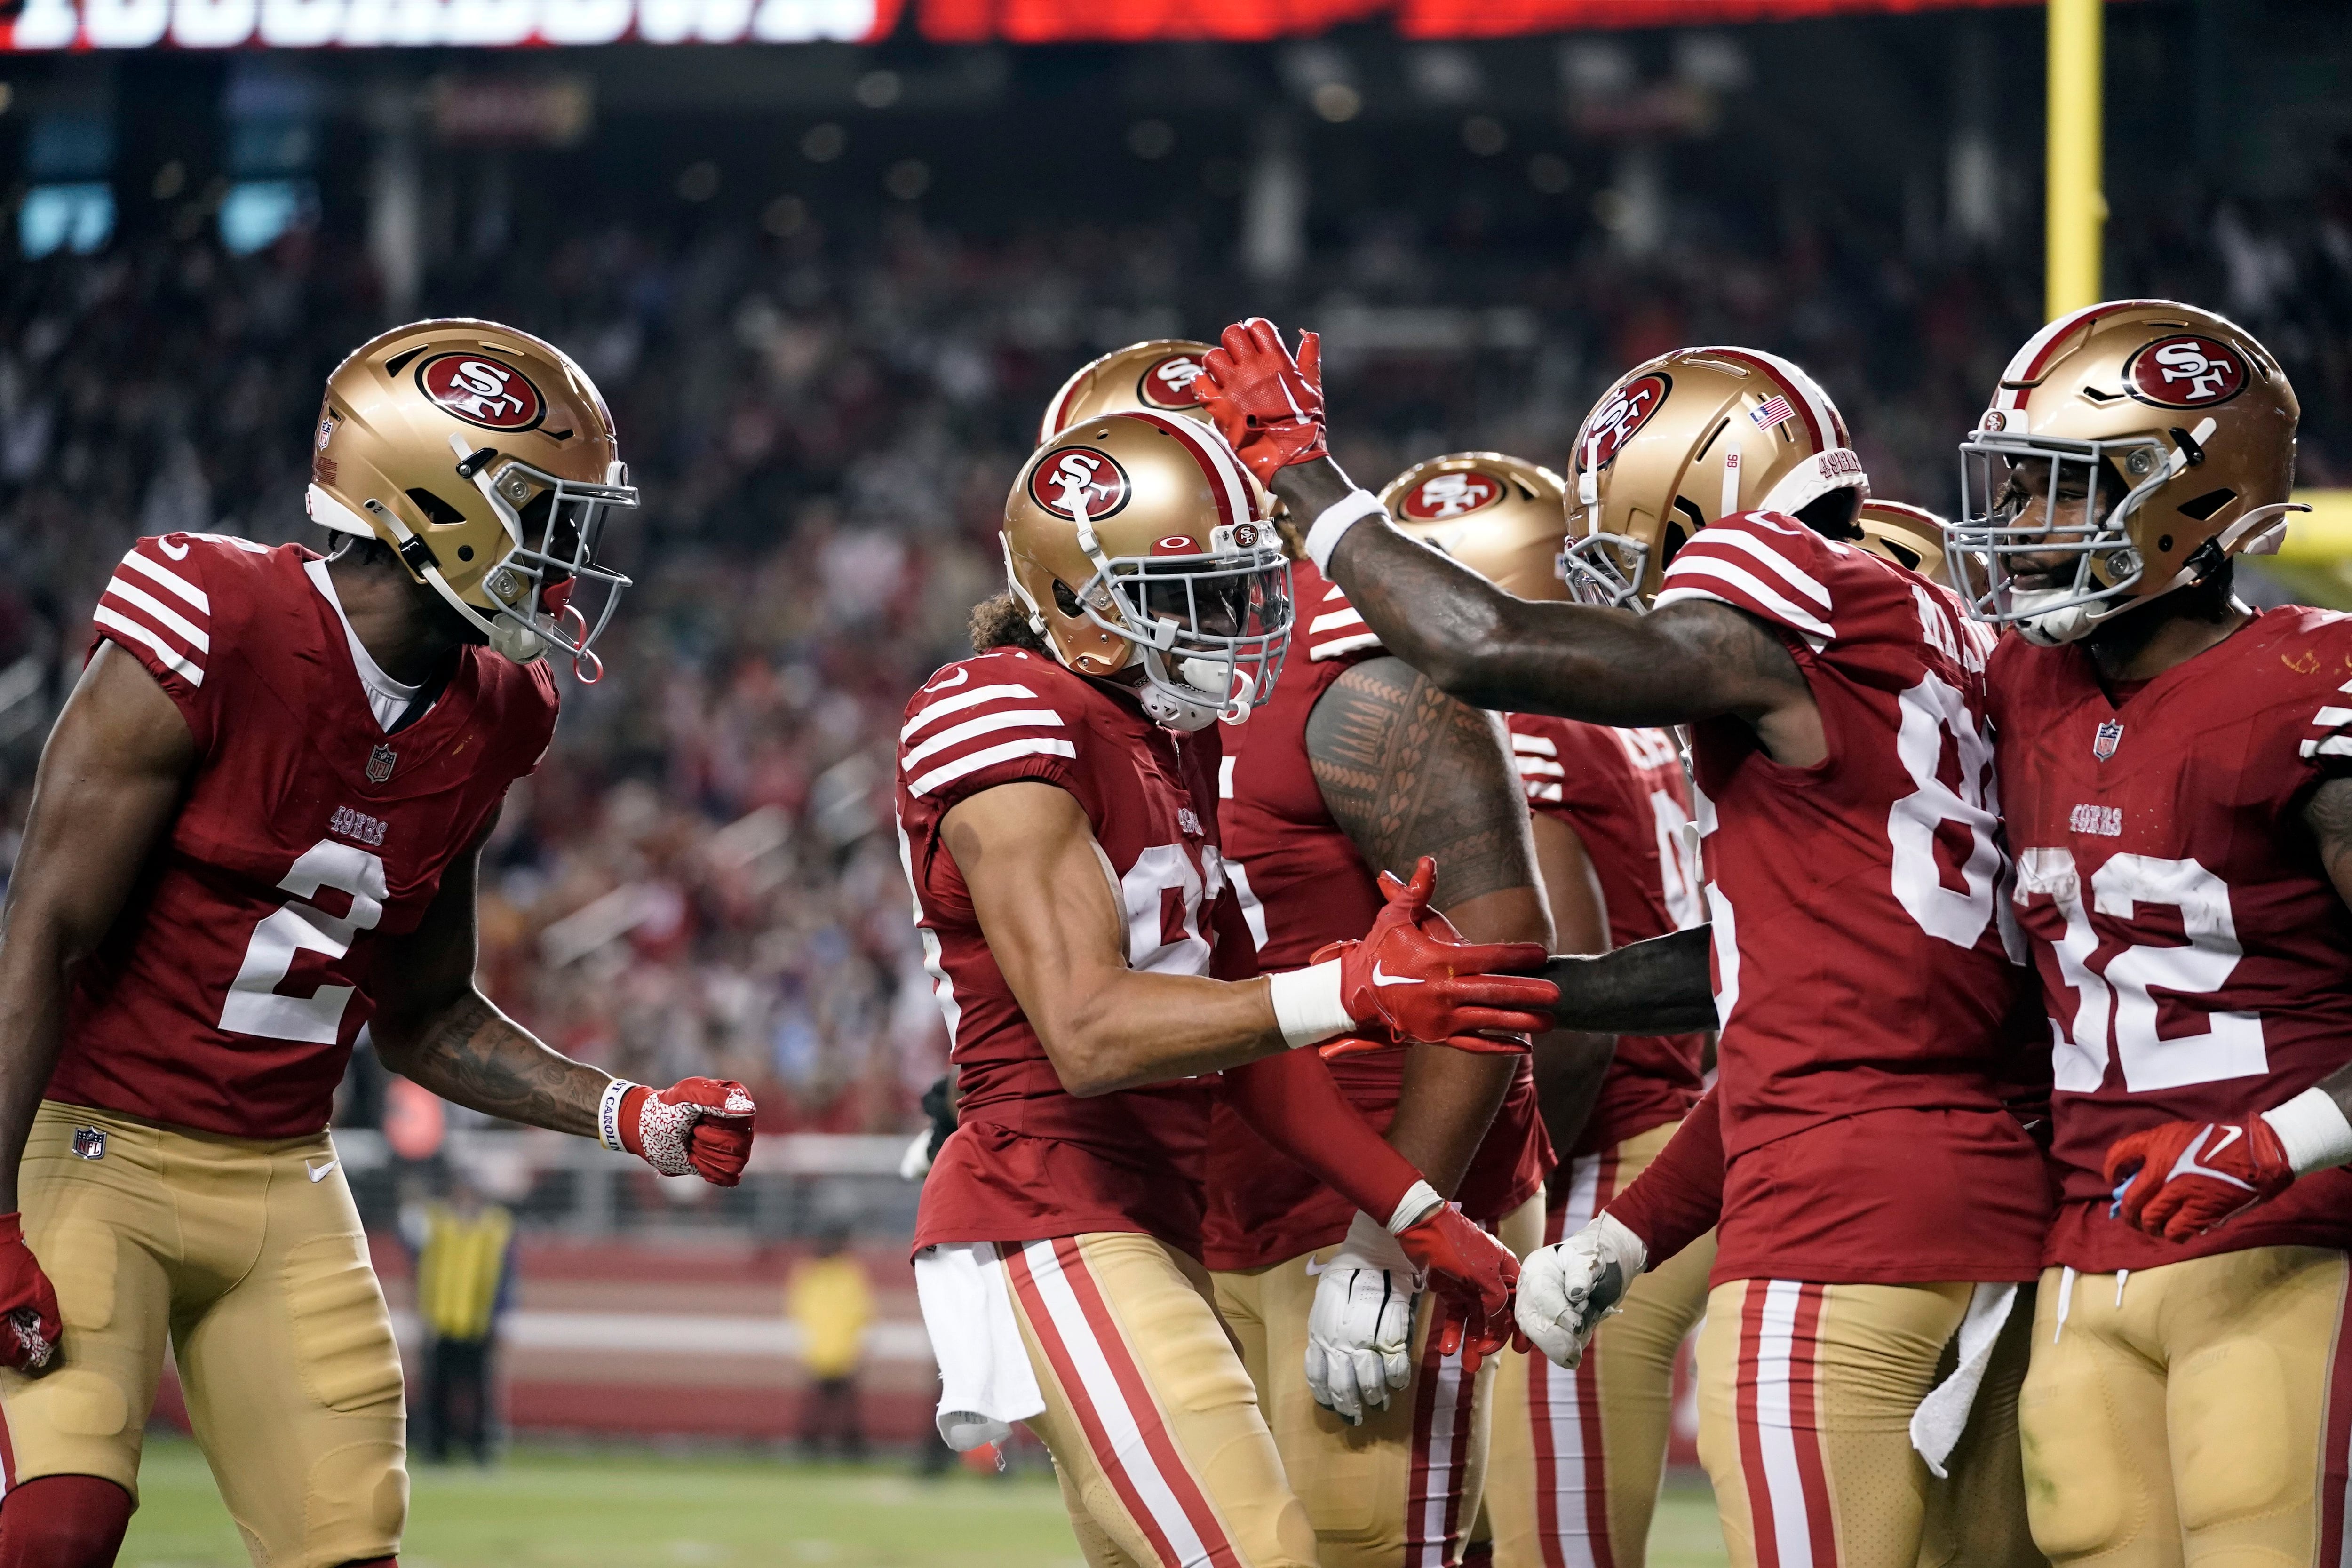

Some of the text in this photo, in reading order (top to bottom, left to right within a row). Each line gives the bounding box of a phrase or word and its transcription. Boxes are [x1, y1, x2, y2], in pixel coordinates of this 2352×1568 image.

[449, 361, 524, 419] SF
[2155, 342, 2233, 399] SF
[1592, 389, 1650, 450] SF
[1727, 454, 1738, 468] 86
[1240, 526, 1255, 544] SF
[369, 759, 389, 777] NFL
[330, 805, 389, 846] 49ERS
[2069, 804, 2122, 837] 49ERS
[217, 838, 390, 1045] 2
[2012, 847, 2269, 1093] 32
[78, 1139, 100, 1154] NFL
[604, 1096, 622, 1152] CAROLIN
